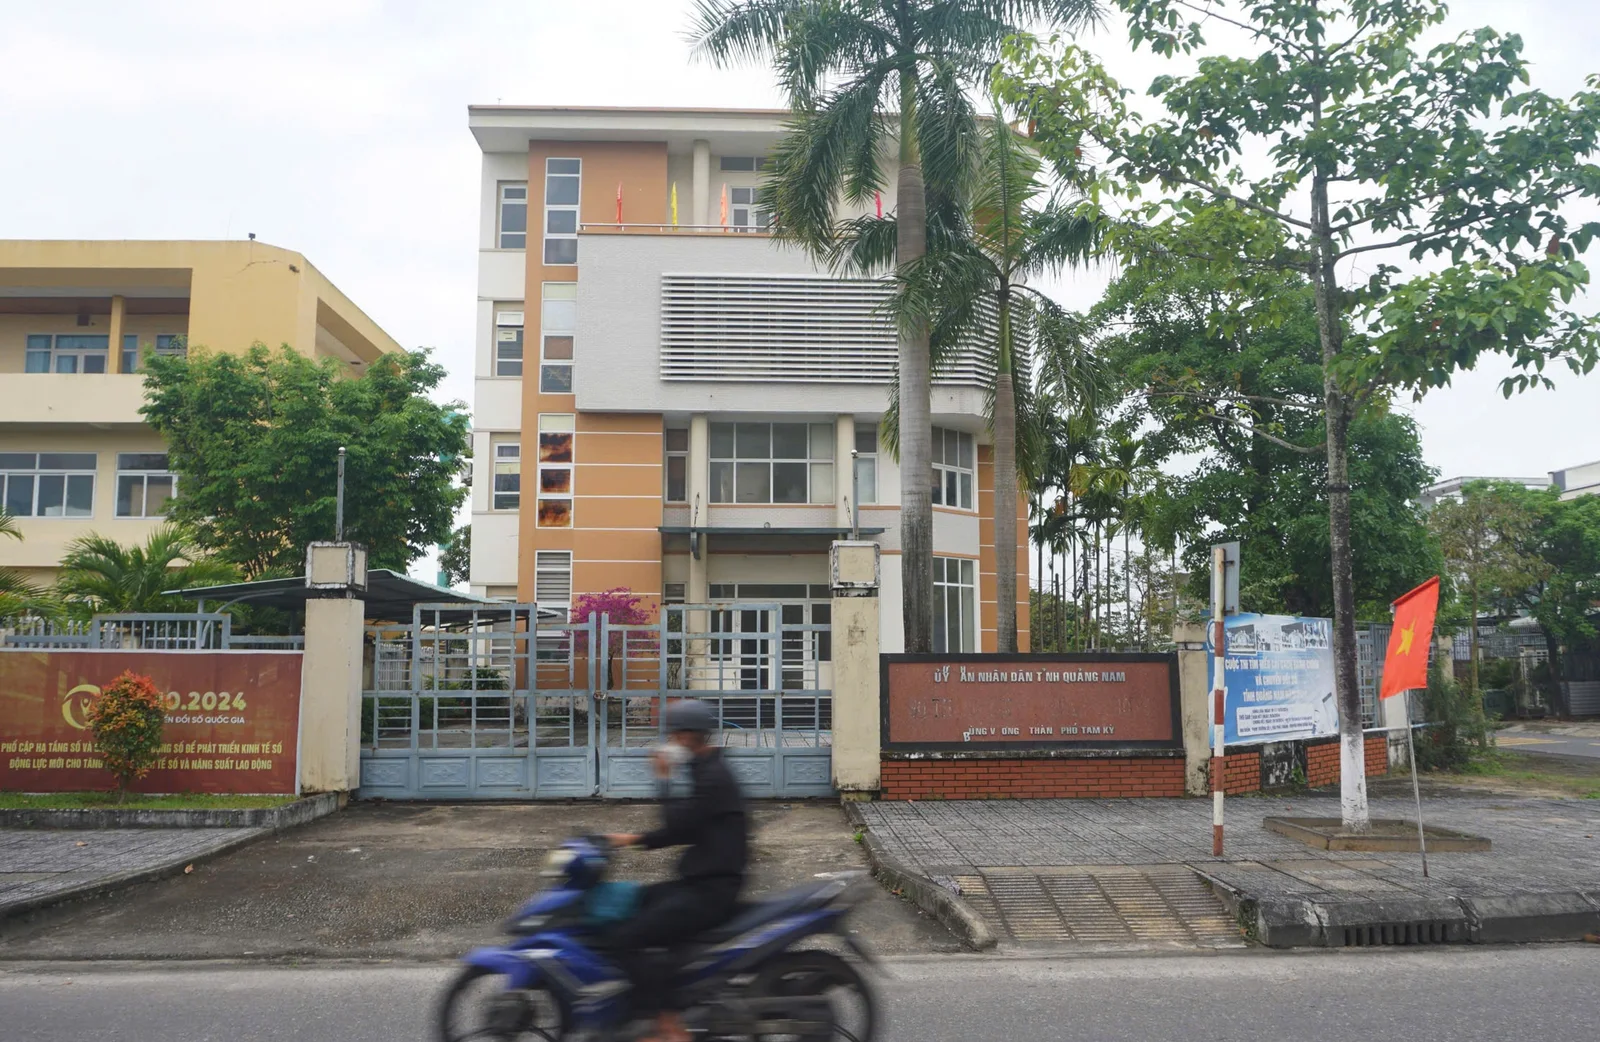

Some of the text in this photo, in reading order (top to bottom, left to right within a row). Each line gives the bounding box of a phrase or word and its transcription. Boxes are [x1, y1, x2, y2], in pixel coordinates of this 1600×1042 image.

[978, 669, 1008, 682] NHÂN
[1011, 669, 1033, 682] DÂN
[1063, 668, 1098, 683] QUẢNG
[1102, 671, 1126, 682] NAM
[192, 714, 203, 724] SỐ
[205, 714, 229, 724] QUỐC
[230, 716, 245, 724] GIA
[1081, 726, 1101, 735] TAM
[70, 739, 82, 753] SỐ
[82, 740, 93, 753] VÀ
[173, 740, 184, 753] SỐ
[197, 741, 217, 753] PHÁT
[241, 743, 260, 753] KINH
[261, 740, 272, 753] TẾ
[272, 740, 283, 753] SỐ
[9, 757, 31, 770] ĐỘNG
[66, 759, 82, 769] CHO
[180, 757, 190, 769] VÀ
[235, 760, 249, 770] LAO
[251, 758, 272, 771] ĐỘNG
